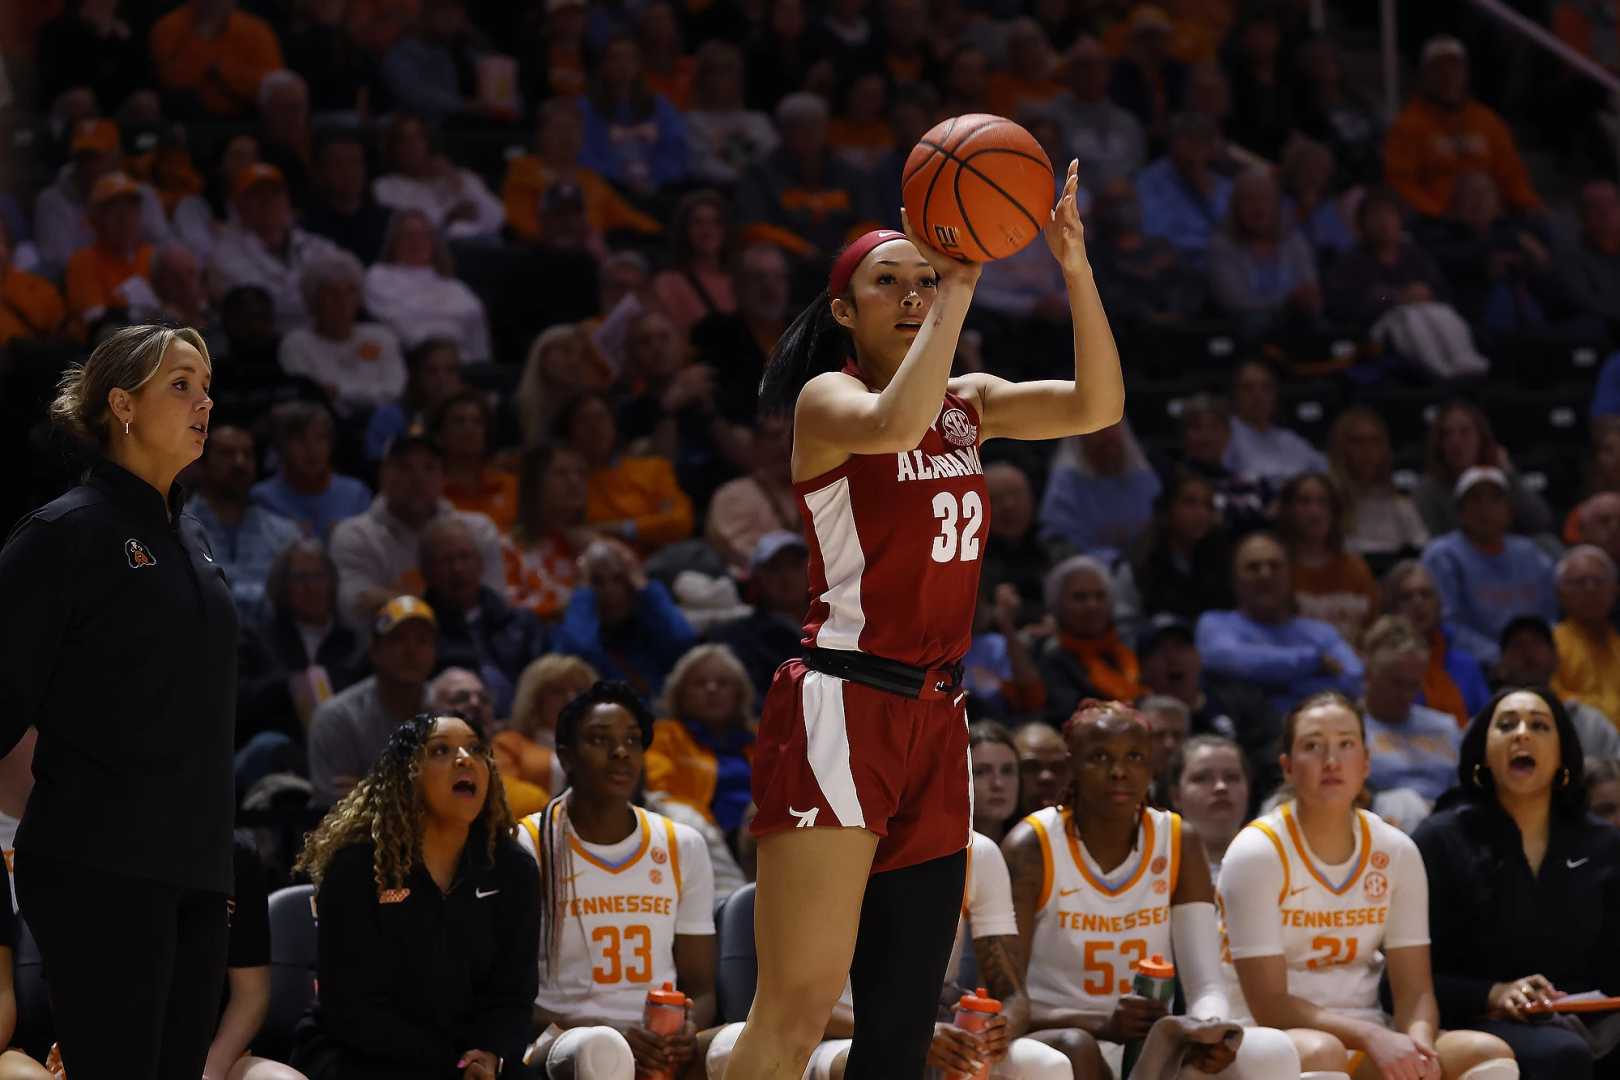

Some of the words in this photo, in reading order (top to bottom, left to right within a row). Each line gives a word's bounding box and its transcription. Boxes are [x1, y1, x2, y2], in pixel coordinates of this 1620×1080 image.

[897, 445, 984, 482] ALABAM
[931, 490, 983, 563] 32
[1281, 907, 1388, 928] TENNESSEE
[592, 924, 653, 984] 33
[1083, 939, 1147, 995] 53
